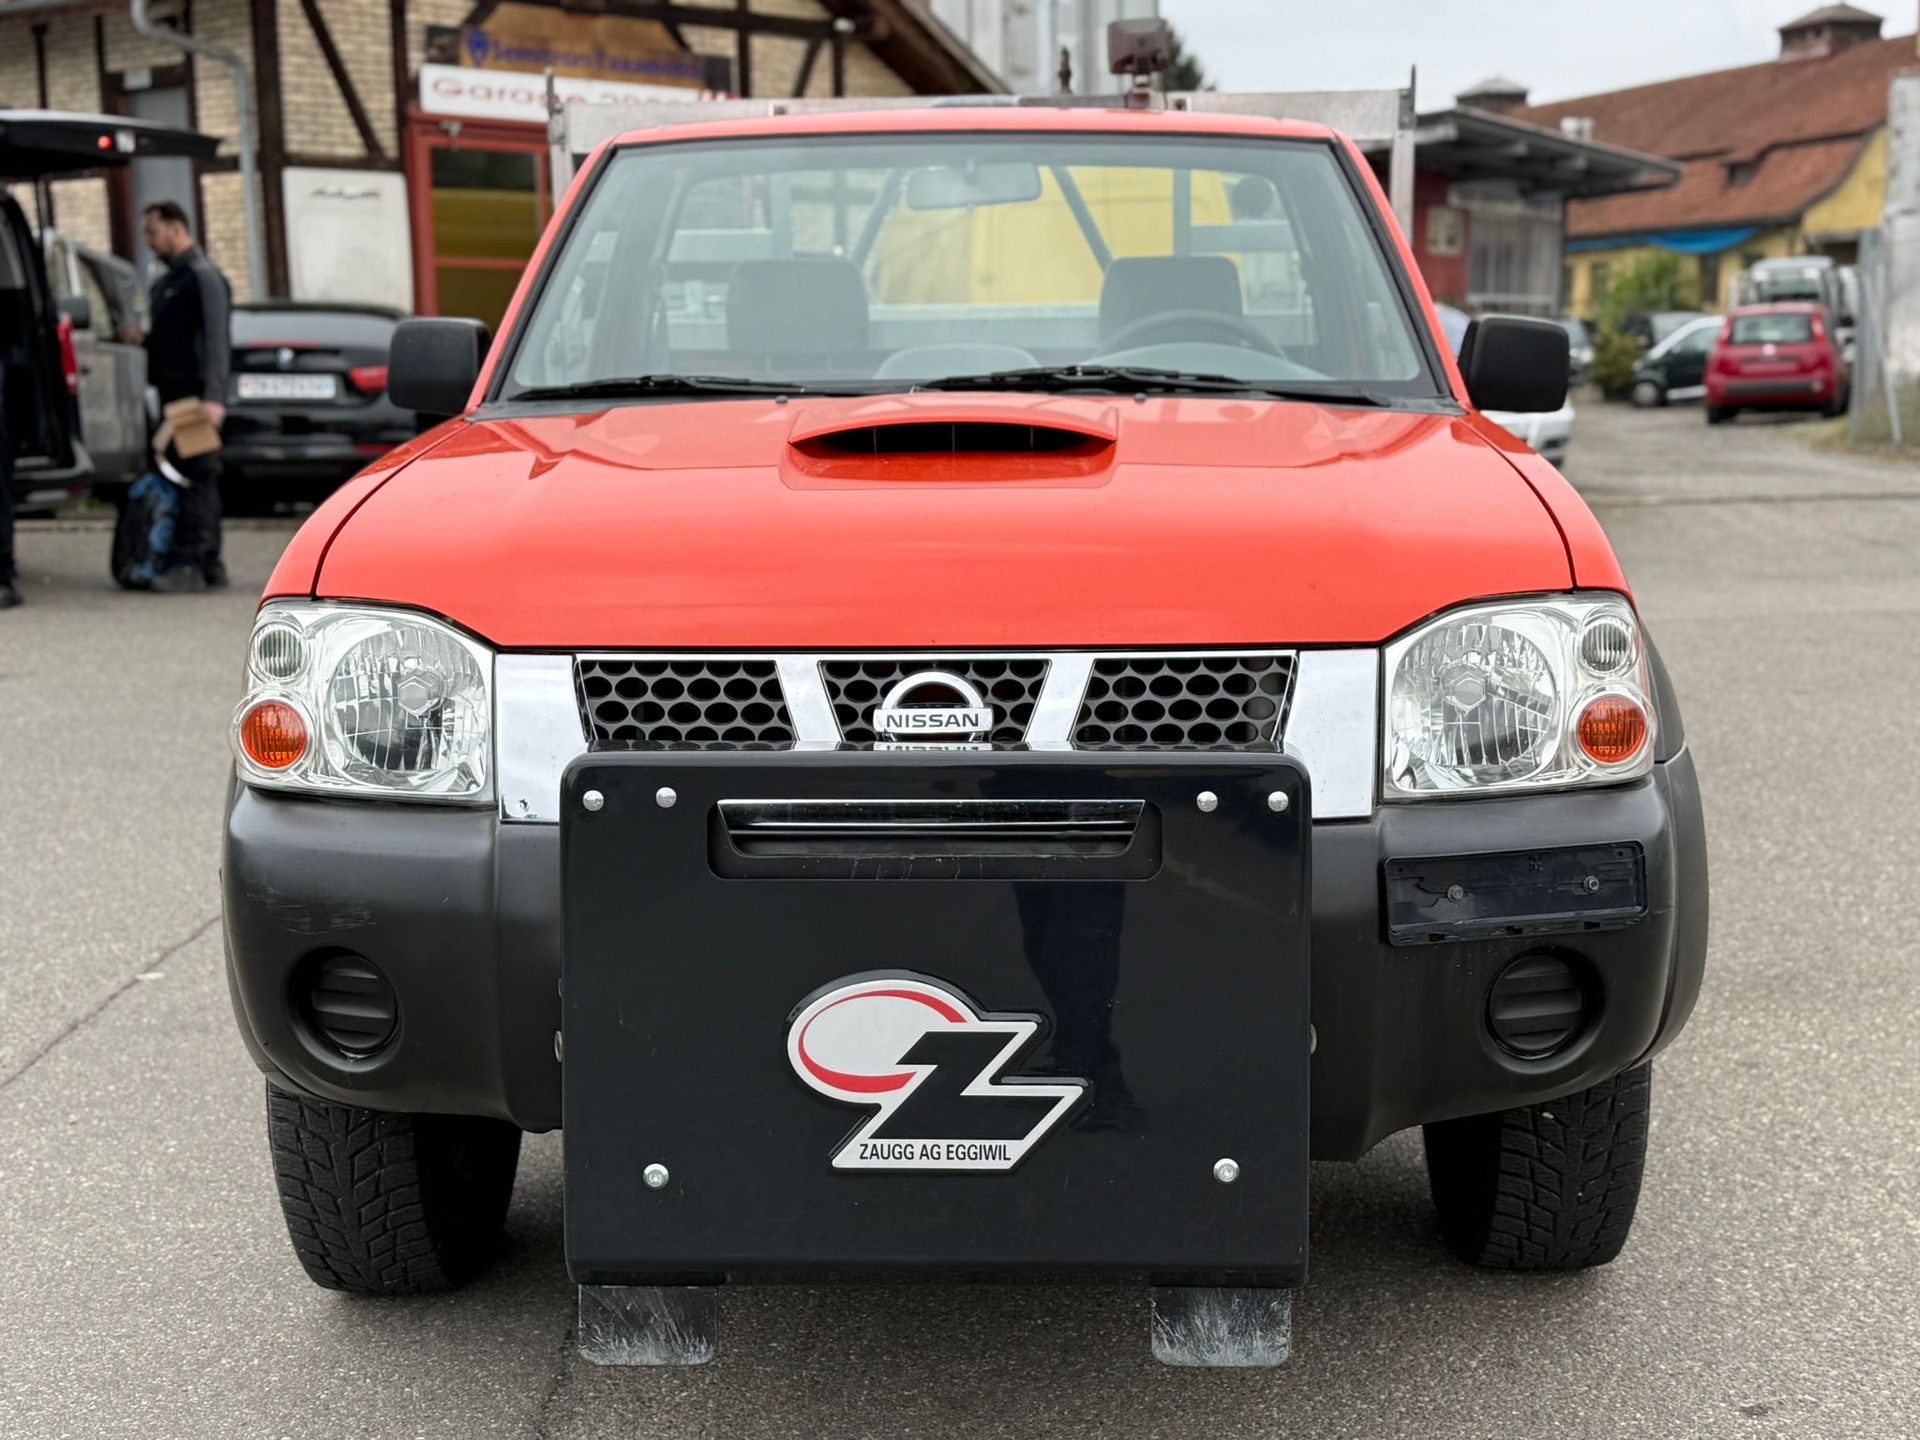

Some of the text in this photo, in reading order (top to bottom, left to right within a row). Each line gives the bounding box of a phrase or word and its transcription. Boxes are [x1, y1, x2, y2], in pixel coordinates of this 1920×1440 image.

[886, 713, 979, 728] NISSAN
[859, 1143, 1011, 1161] ZAUGG AG EGGIWIL
